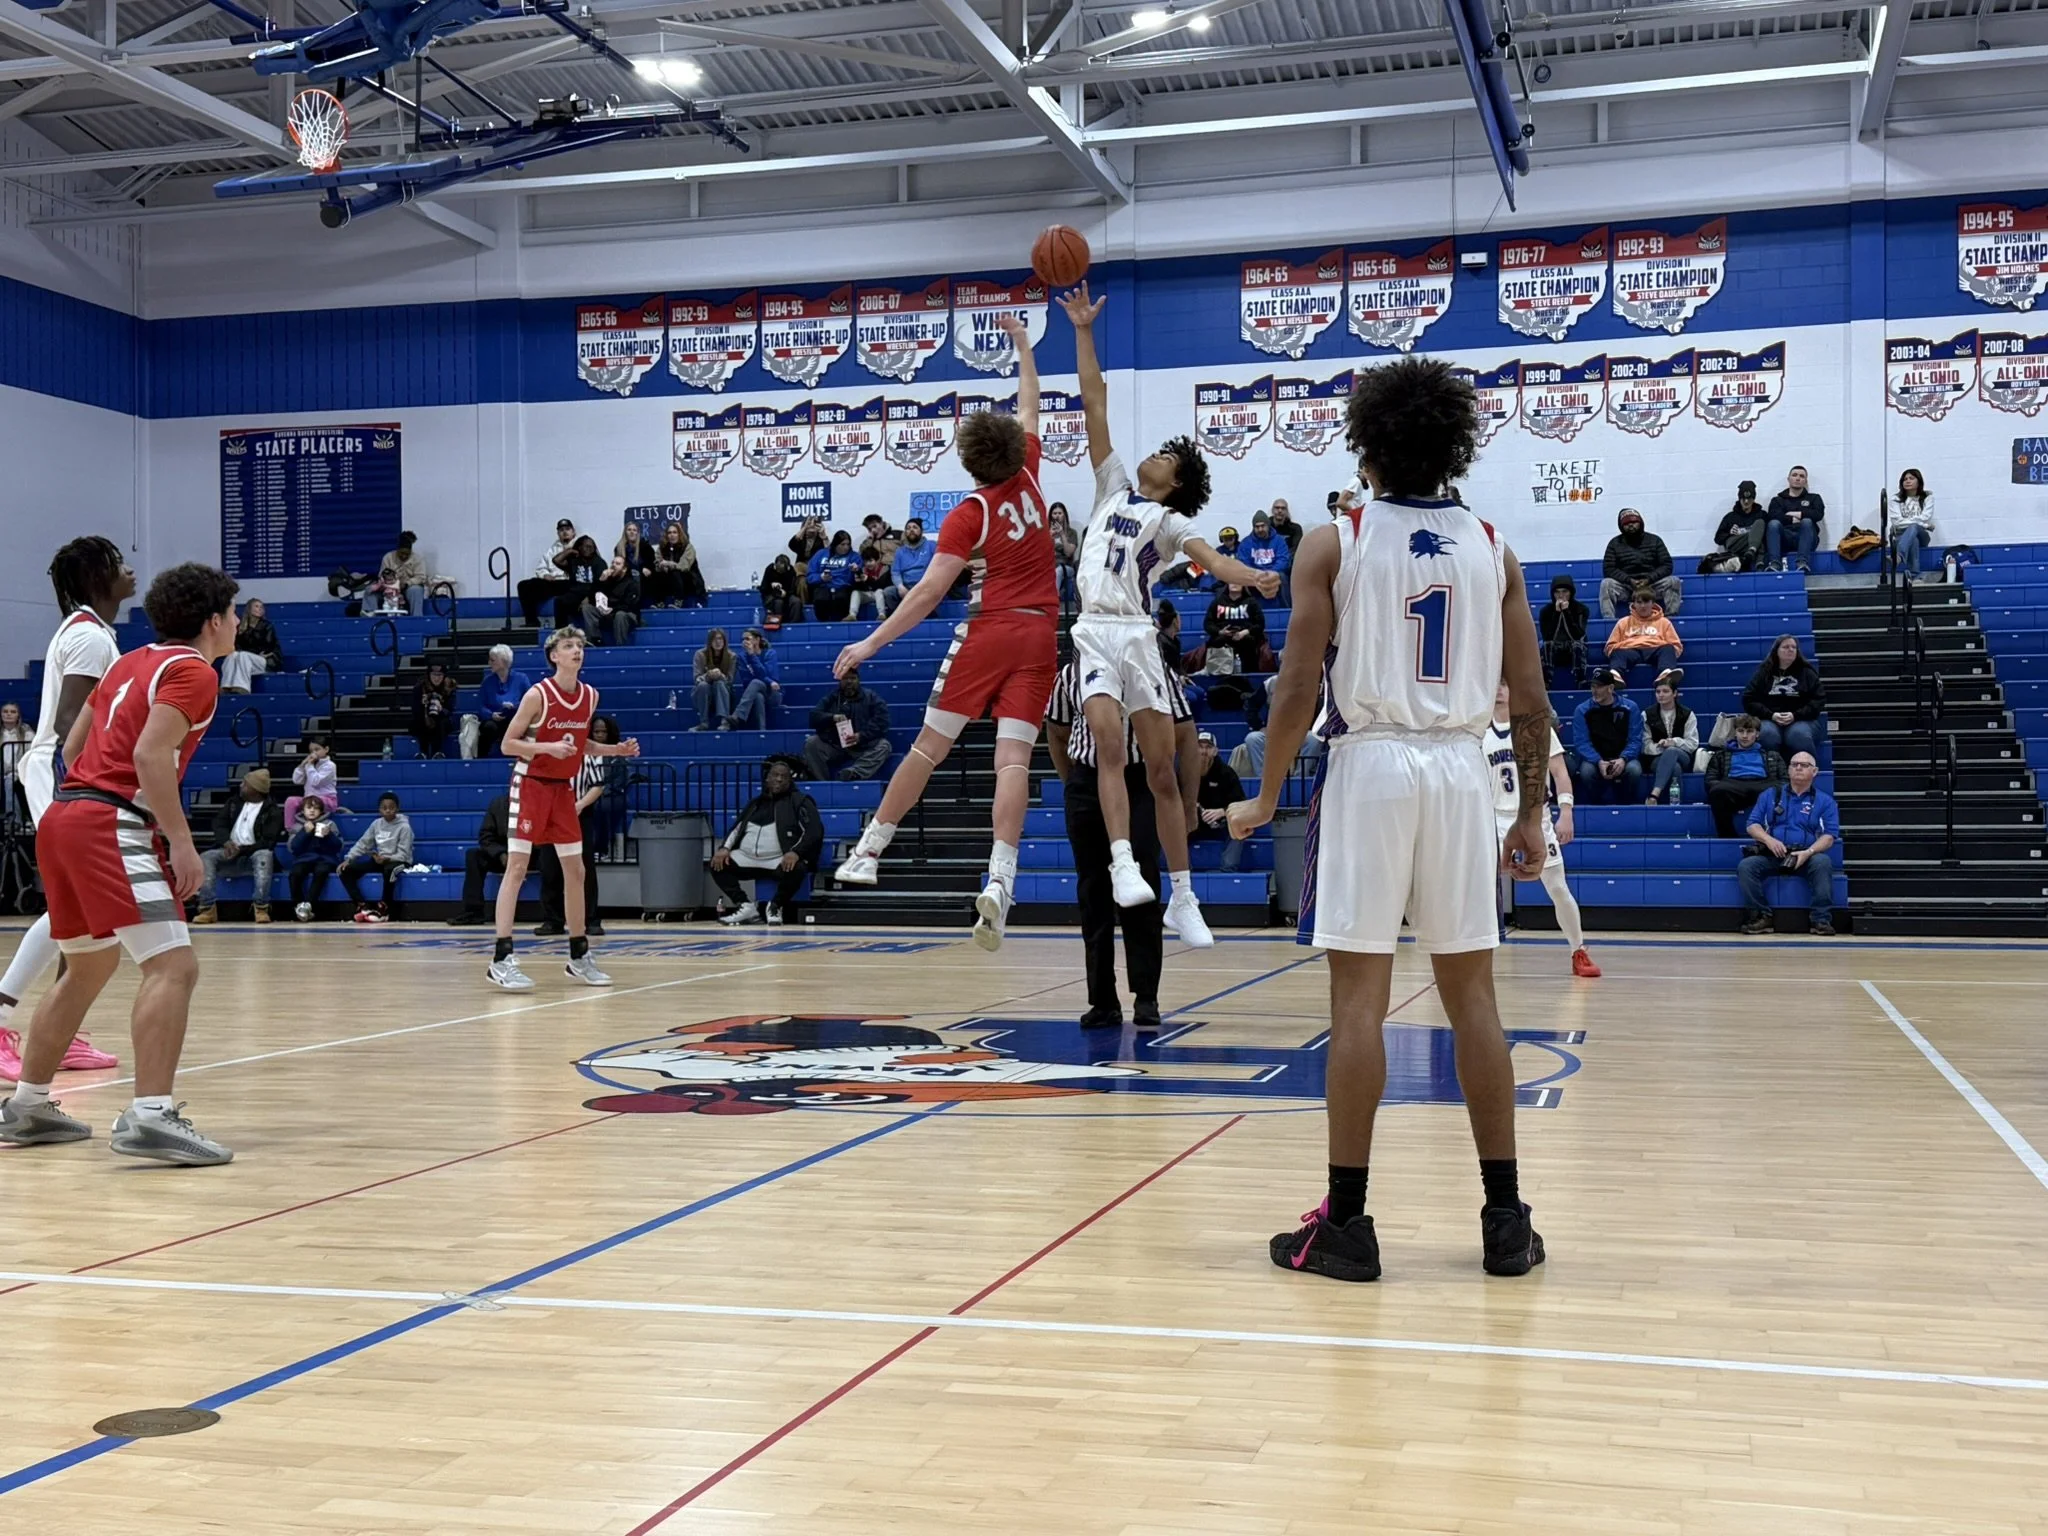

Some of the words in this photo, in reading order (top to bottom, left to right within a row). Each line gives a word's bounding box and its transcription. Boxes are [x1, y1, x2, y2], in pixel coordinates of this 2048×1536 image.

[1964, 210, 2014, 230] 1994-95
[1994, 232, 2032, 244] DIVISION
[2034, 232, 2041, 242] II
[1618, 237, 1664, 257] 1992-93
[1503, 246, 1546, 265] 1976-77
[1965, 246, 2001, 266] STATE
[1352, 258, 1396, 277] 1965-66
[1646, 260, 1683, 270] DIVISION
[1684, 258, 1690, 268] II
[1996, 266, 2010, 274] JIM
[2011, 264, 2040, 273] HOLMES
[1245, 266, 1288, 284] 1964-65
[1530, 269, 1555, 279] CLASS
[1556, 267, 1574, 277] AAA
[1620, 272, 1653, 291] STATE
[1656, 268, 1717, 288] CHAMPION
[1999, 276, 2036, 284] WRESTLING
[957, 286, 978, 296] TEAM
[1379, 280, 1402, 290] CLASS
[1403, 279, 1420, 289] AAA
[1504, 281, 1538, 300] STATE
[1540, 276, 1600, 297] CHAMPION
[957, 296, 978, 304] STATE
[980, 293, 1011, 303] CHAMPS
[1271, 288, 1294, 298] CLASS
[1294, 287, 1312, 296] AAA
[1354, 293, 1384, 310] STATE
[1387, 288, 1446, 308] CHAMPION
[1636, 290, 1658, 299] STEVE
[1658, 288, 1700, 298] DAUGHERTY
[765, 301, 804, 317] 1994-95
[860, 294, 901, 311] 2006-07
[1247, 300, 1277, 318] STATE
[1279, 296, 1335, 316] CHAMPION
[1530, 298, 1551, 308] STEVE
[1552, 297, 1574, 306] REEDY
[1650, 300, 1686, 310] WRESTLING
[580, 311, 617, 327] 1965-66
[672, 306, 709, 322] 1992-93
[884, 315, 914, 324] DIVISION
[915, 314, 920, 322] II
[1394, 308, 1422, 318] HEISLER
[1534, 308, 1570, 318] WRESTLING
[1669, 308, 1680, 316] LBS
[788, 321, 818, 330] DIVISION
[818, 320, 824, 328] II
[1286, 315, 1312, 325] HEISLER
[602, 331, 622, 340] CLASS
[624, 330, 637, 339] AAA
[695, 326, 724, 335] DIVISION
[858, 327, 886, 343] STATE
[888, 323, 945, 341] RUNNER-UP
[671, 338, 698, 354] STATE
[699, 334, 752, 352] CHAMPIONS
[764, 332, 790, 348] STATE
[793, 329, 848, 346] RUNNER-UP
[580, 342, 606, 358] STATE
[608, 339, 660, 357] CHAMPIONS
[886, 342, 919, 350] WRESTLING
[1890, 344, 1930, 360] 2003-04
[1984, 340, 2024, 354] 2007-08
[1700, 358, 1737, 372] 2002-03
[1912, 362, 1942, 370] DIVISION
[2006, 358, 2036, 366] DIVISION
[2036, 356, 2044, 364] III
[1526, 369, 1561, 383] 1999-00
[1612, 363, 1648, 378] 2002-03
[1722, 374, 1750, 382] DIVISION
[1904, 370, 1960, 386] ALL-OHIO
[2024, 380, 2040, 388] DAVIS
[1200, 390, 1230, 402] 1990-91
[1278, 384, 1309, 398] 1991-92
[1546, 386, 1573, 394] DIVISION
[1624, 388, 1676, 402] ALL-OHIO
[1712, 382, 1766, 396] ALL-OHIO
[1039, 398, 1066, 410] 987-88
[1537, 394, 1588, 408] ALL-OHIO
[746, 413, 776, 426] 1979-80
[817, 410, 846, 422] 1982-83
[889, 406, 918, 419] 1987-88
[1210, 412, 1257, 426] ALL-OHIO
[1290, 408, 1338, 422] ALL-OHIO
[676, 416, 705, 429] 1979-80
[826, 432, 870, 445] ALL-OHIO
[898, 428, 942, 441] ALL-OHIO
[256, 439, 296, 456] STATE
[300, 437, 362, 454] PLACERS
[686, 438, 728, 452] ALL-OHIO
[756, 436, 798, 448] ALL-OHIO
[1536, 461, 1579, 477] TAKE
[1584, 460, 1600, 474] IT
[1544, 478, 1564, 490] TO
[1568, 475, 1592, 489] THE
[789, 486, 824, 500] HOME
[912, 495, 936, 510] GO
[666, 506, 682, 520] GO
[784, 503, 830, 518] ADULTS
[997, 490, 1043, 541] 34
[1217, 604, 1249, 619] PINK
[1405, 584, 1452, 683] 1
[104, 677, 135, 732] 1
[547, 717, 590, 729] Crestwood
[1488, 749, 1515, 767] RAVEN
[1502, 768, 1514, 792] 3
[1548, 844, 1557, 857] 3
